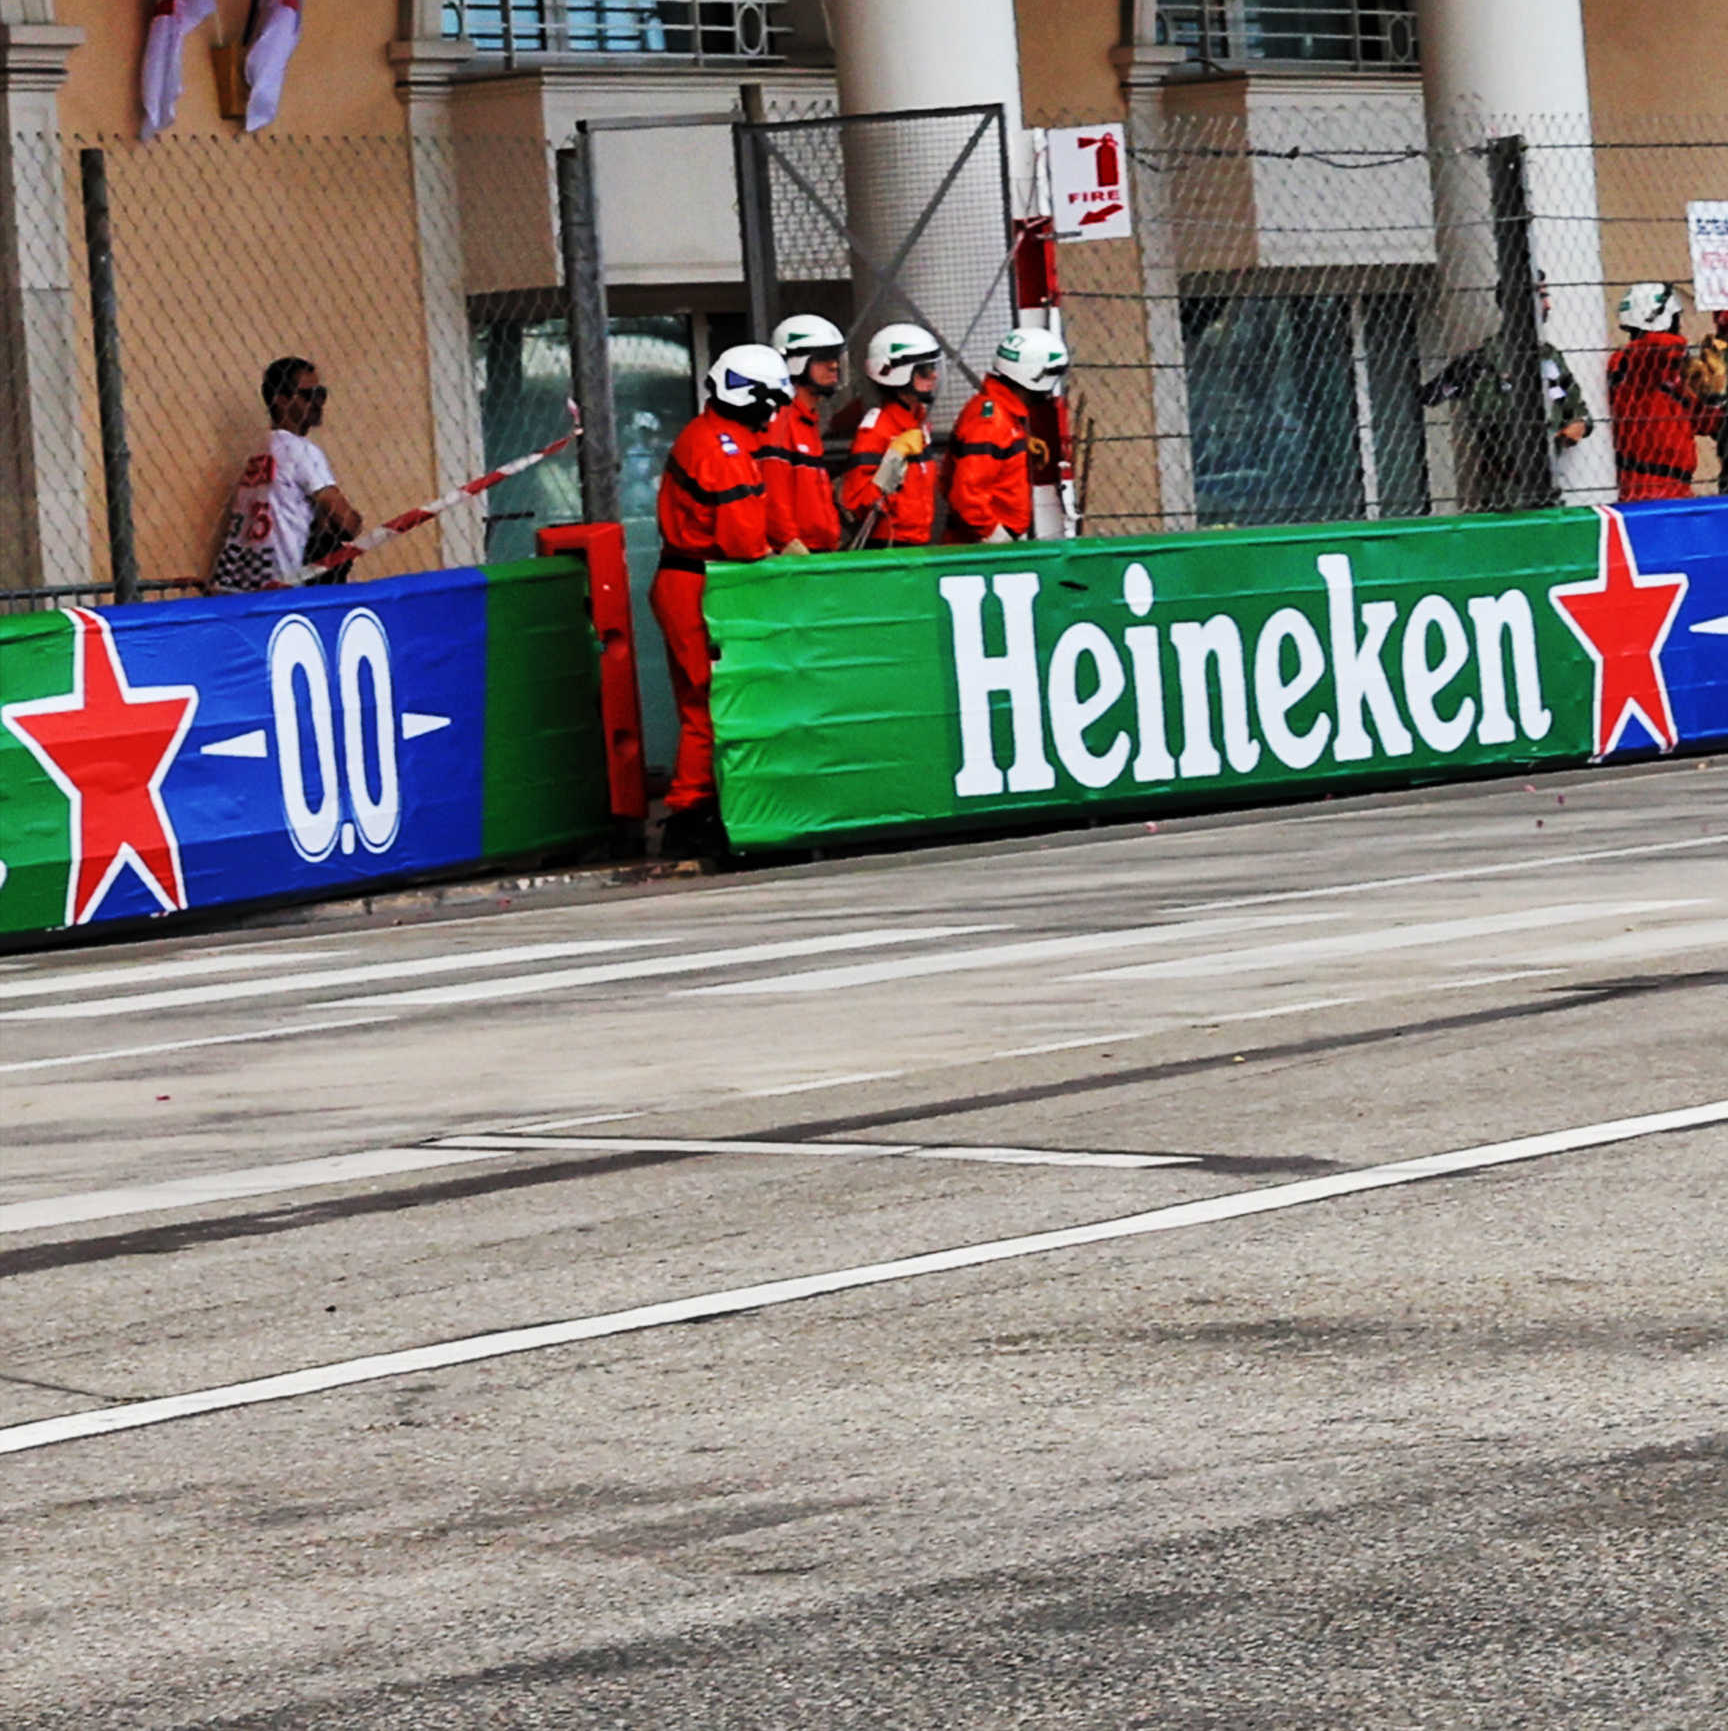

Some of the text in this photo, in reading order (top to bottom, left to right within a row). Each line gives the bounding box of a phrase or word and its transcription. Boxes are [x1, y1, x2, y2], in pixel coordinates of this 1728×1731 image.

[1068, 190, 1121, 205] FIRE
[267, 606, 402, 863] 0.0
[940, 554, 1552, 797] Heineken
